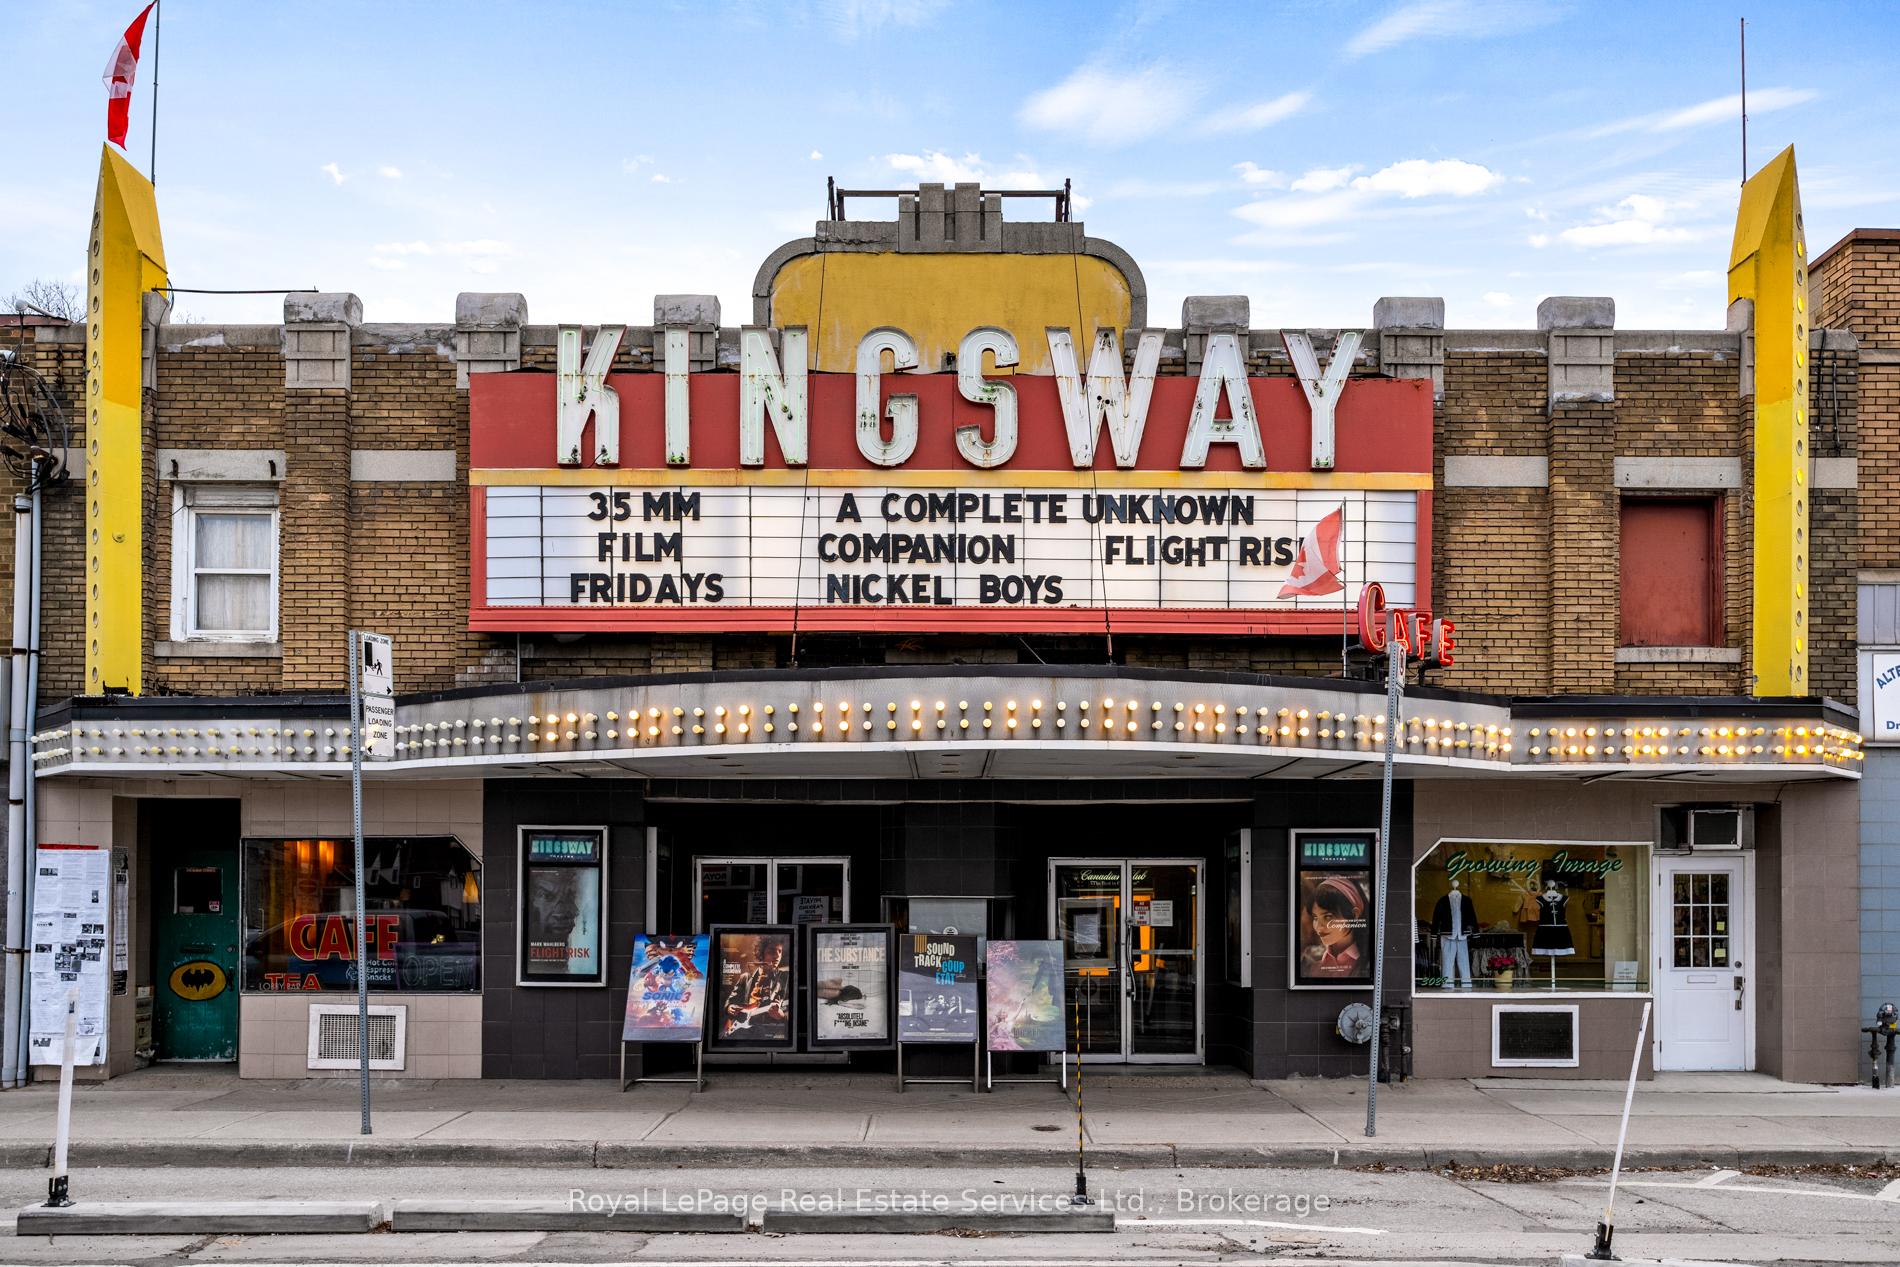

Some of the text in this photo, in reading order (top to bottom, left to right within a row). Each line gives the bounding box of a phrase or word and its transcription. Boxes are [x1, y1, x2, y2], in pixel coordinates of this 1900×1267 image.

[556, 324, 1365, 470] KINGSWAY
[588, 491, 701, 522] 35 MM
[836, 492, 1255, 526] A COMPLETE UNKNOWN
[598, 531, 683, 563] FILM
[818, 532, 1015, 565] COMPANION
[1105, 534, 1304, 567] FLIGHT RIS
[571, 572, 724, 604] FRIDAYS
[826, 573, 1063, 605] NICKEL BOYS
[1358, 581, 1455, 666] CAFE
[365, 704, 394, 716] PASSENGER
[368, 717, 392, 728] LOADING
[372, 731, 388, 740] ZONE
[531, 839, 593, 855] KINGSWAY
[1304, 842, 1366, 857] KINGSWAY
[1445, 849, 1623, 881] Growing Image
[1132, 870, 1149, 881] lub
[1327, 919, 1367, 931] Companion
[289, 913, 400, 961] CAFE
[530, 947, 590, 959] FLIGHT RISK
[817, 947, 885, 963] THE SUBSTANCE
[927, 942, 955, 957] SOUND
[914, 953, 941, 968] TRACK
[941, 959, 965, 973] COUP
[367, 967, 396, 975] Espress
[403, 956, 475, 987] OPEN
[264, 973, 321, 991] TEA
[642, 991, 692, 1003] SONIC 3
